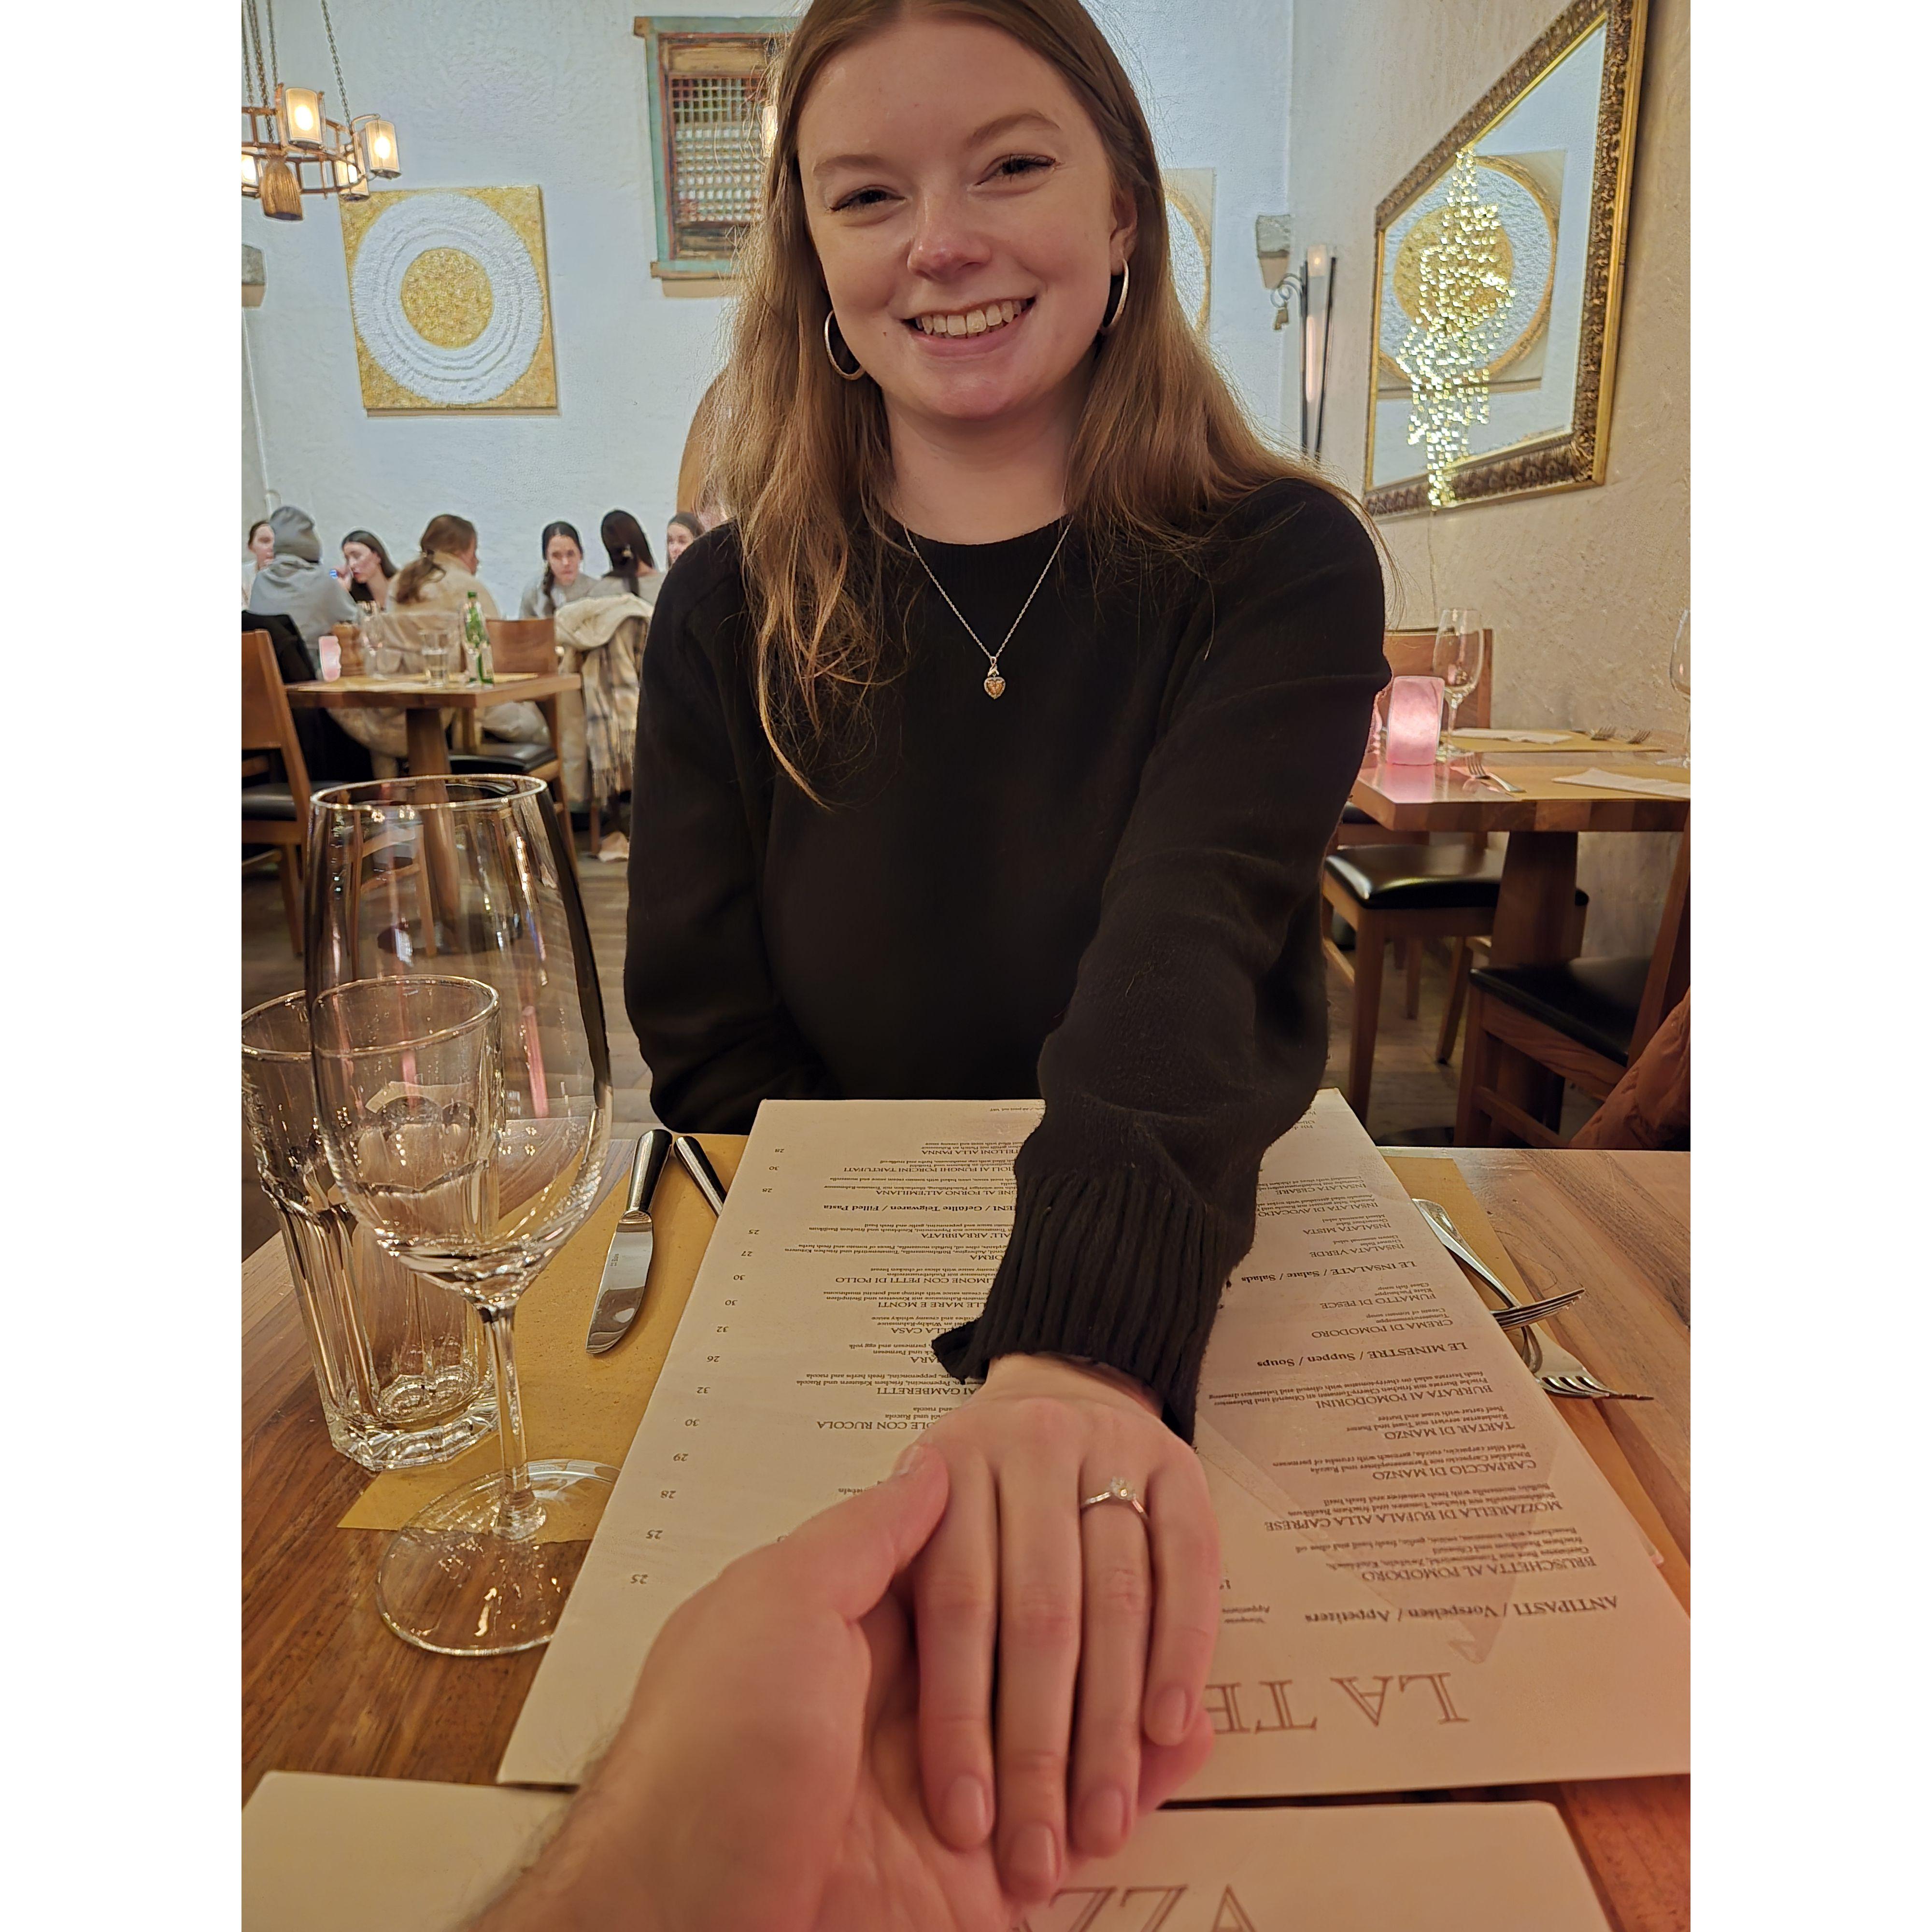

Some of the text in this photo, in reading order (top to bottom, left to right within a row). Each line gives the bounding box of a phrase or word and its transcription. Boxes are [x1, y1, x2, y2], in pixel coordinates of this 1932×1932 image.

[1275, 1187, 1316, 1195] CESARE
[1316, 1183, 1366, 1192] INSALATA
[1257, 1208, 1310, 1217] AVOCADO
[1328, 1202, 1378, 1212] INSALATA
[1338, 1222, 1391, 1232] INSALATA
[1308, 1243, 1405, 1258] INSALATA VERDE
[1286, 1271, 1320, 1279] Salate
[1330, 1263, 1396, 1276] INSALATE
[1241, 1274, 1276, 1283] Salads
[1319, 1300, 1356, 1309] PESCE
[1375, 1293, 1436, 1305] FUMATTO
[1406, 1319, 1453, 1329] CREMA
[1310, 1325, 1388, 1338] POMODORO
[707, 1354, 720, 1363] 26
[1257, 1341, 1468, 1368] LE MINESTRE Suppen Soups
[696, 1386, 711, 1395] 32
[1314, 1385, 1493, 1409] BURRATA AI POMODORINI
[684, 1418, 699, 1427] 30
[816, 1421, 873, 1429] RUCOLA
[1384, 1421, 1515, 1440] TARTAR DI MANZO
[673, 1452, 689, 1462] 29
[1372, 1460, 1536, 1480] CARPACCIO DI MANZO
[660, 1490, 676, 1499] 28
[1264, 1501, 1563, 1532] MOZZARELLA DI BUFALA ALLA CAPRESE
[645, 1529, 663, 1540] 25
[1486, 1556, 1597, 1574] BRUSCHETTA
[1362, 1567, 1461, 1582] POMODORO
[1461, 1565, 1482, 1577] AL
[630, 1574, 648, 1585] 25
[1305, 1595, 1617, 1624] ANTIPASTI Vorspeisen Appetizers
[1329, 1672, 1470, 1728] LA
